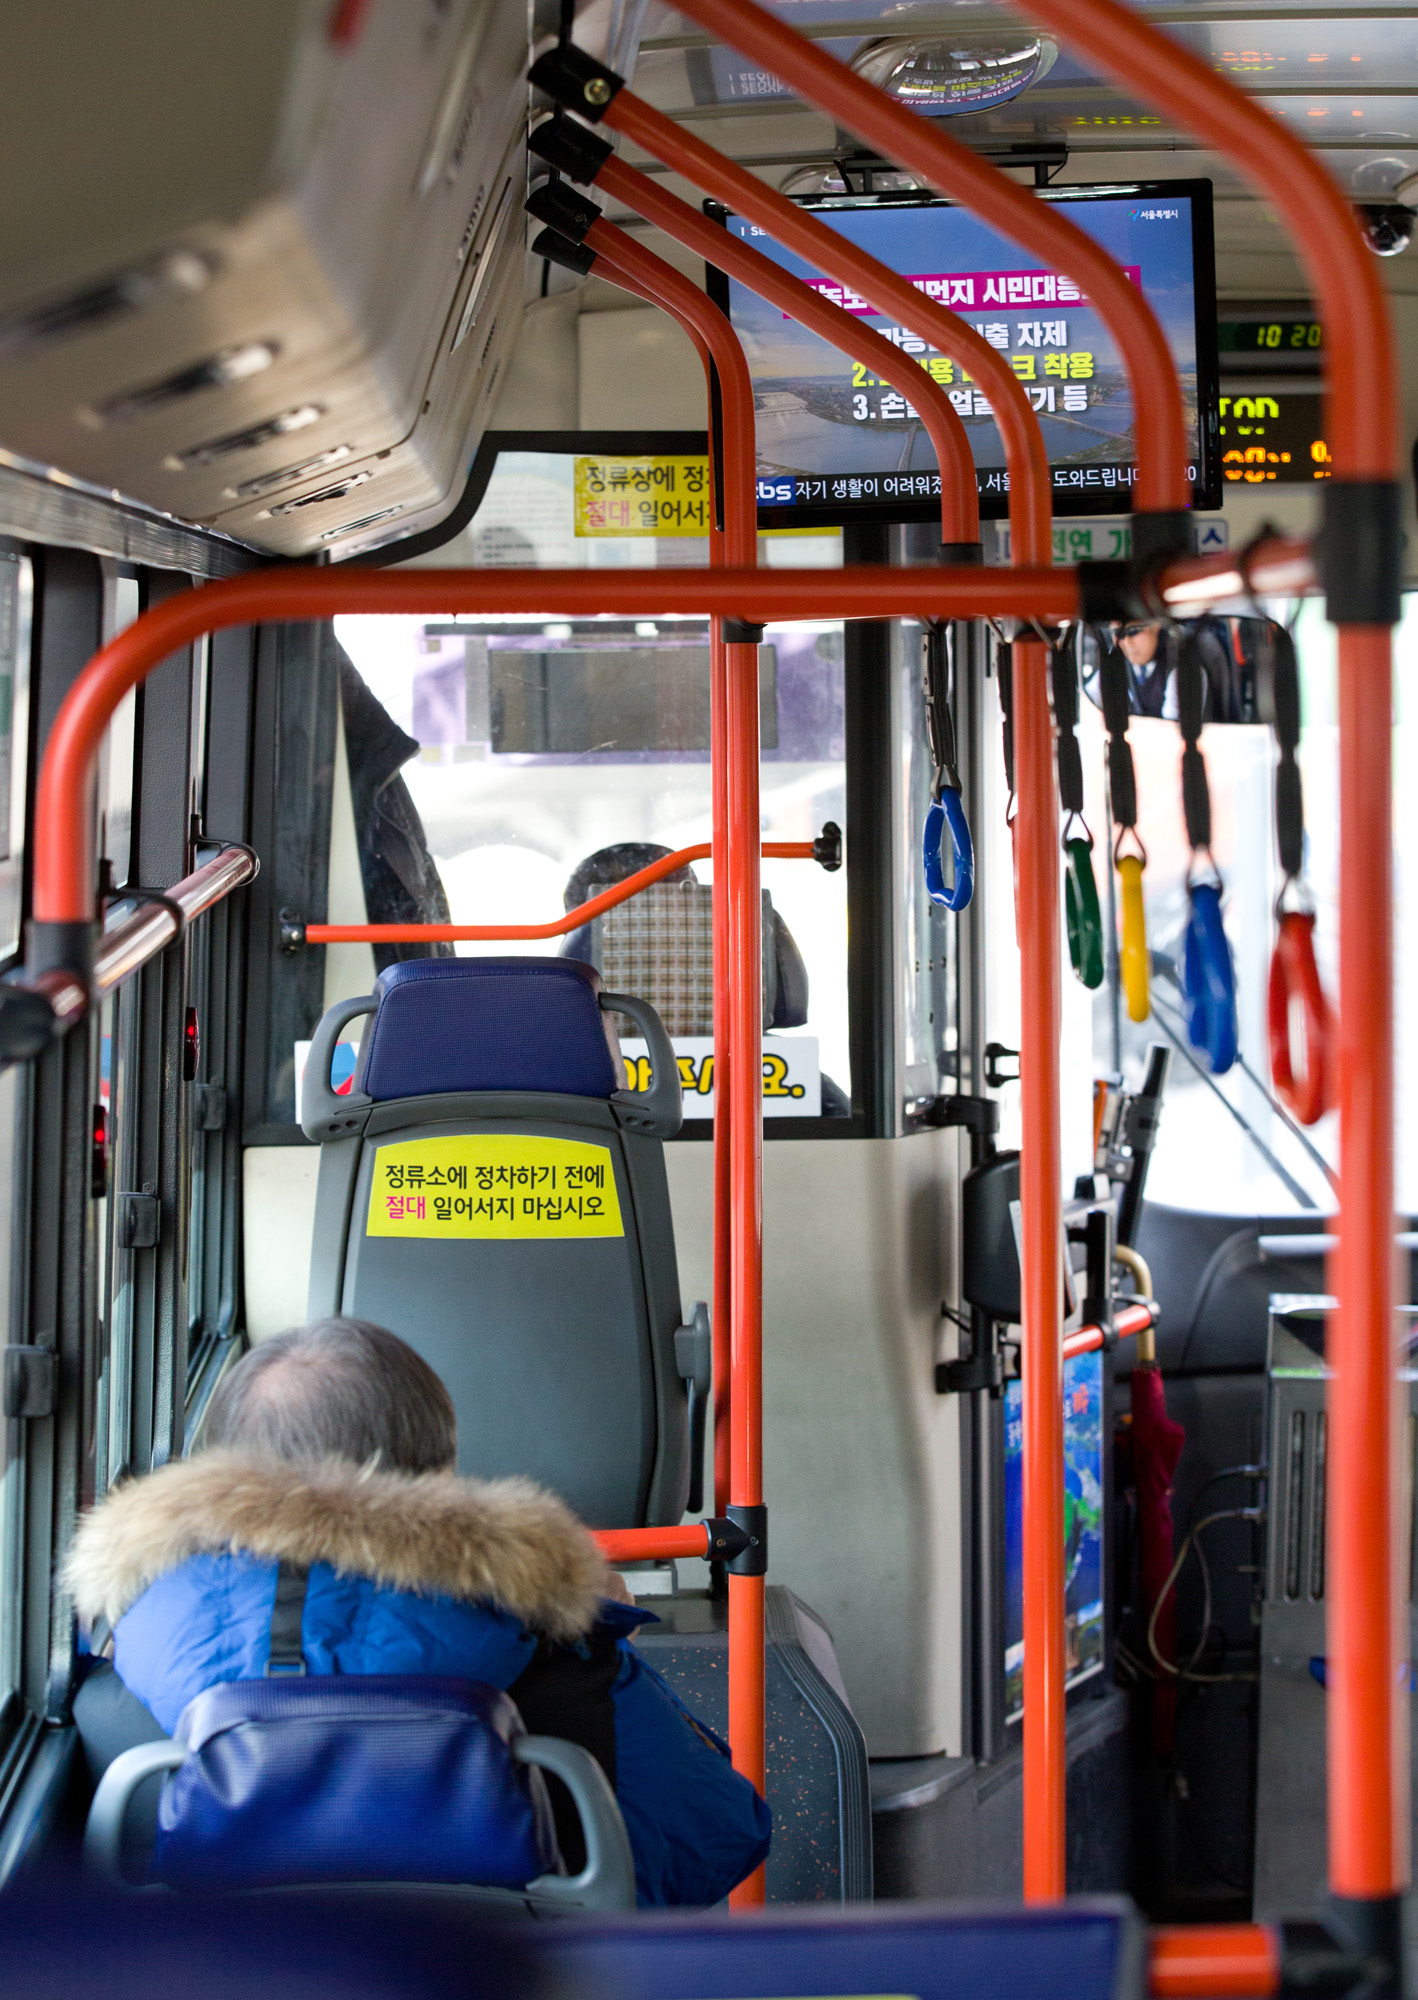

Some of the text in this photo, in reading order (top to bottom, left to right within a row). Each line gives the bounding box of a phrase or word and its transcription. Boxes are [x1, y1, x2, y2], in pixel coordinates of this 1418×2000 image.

[1140, 204, 1179, 220] 서울특별시
[1017, 320, 1068, 348] 자제
[1044, 351, 1094, 380] 착용
[1063, 385, 1088, 412] 등
[584, 465, 709, 493] 정류장에 정
[795, 480, 827, 500] 자기
[831, 477, 879, 499] 생활이
[585, 500, 710, 528] 절대 일어서
[385, 1164, 605, 1190] 정류소에 정차하기 전에
[385, 1195, 605, 1221] 절대 일어서지 마십시오
